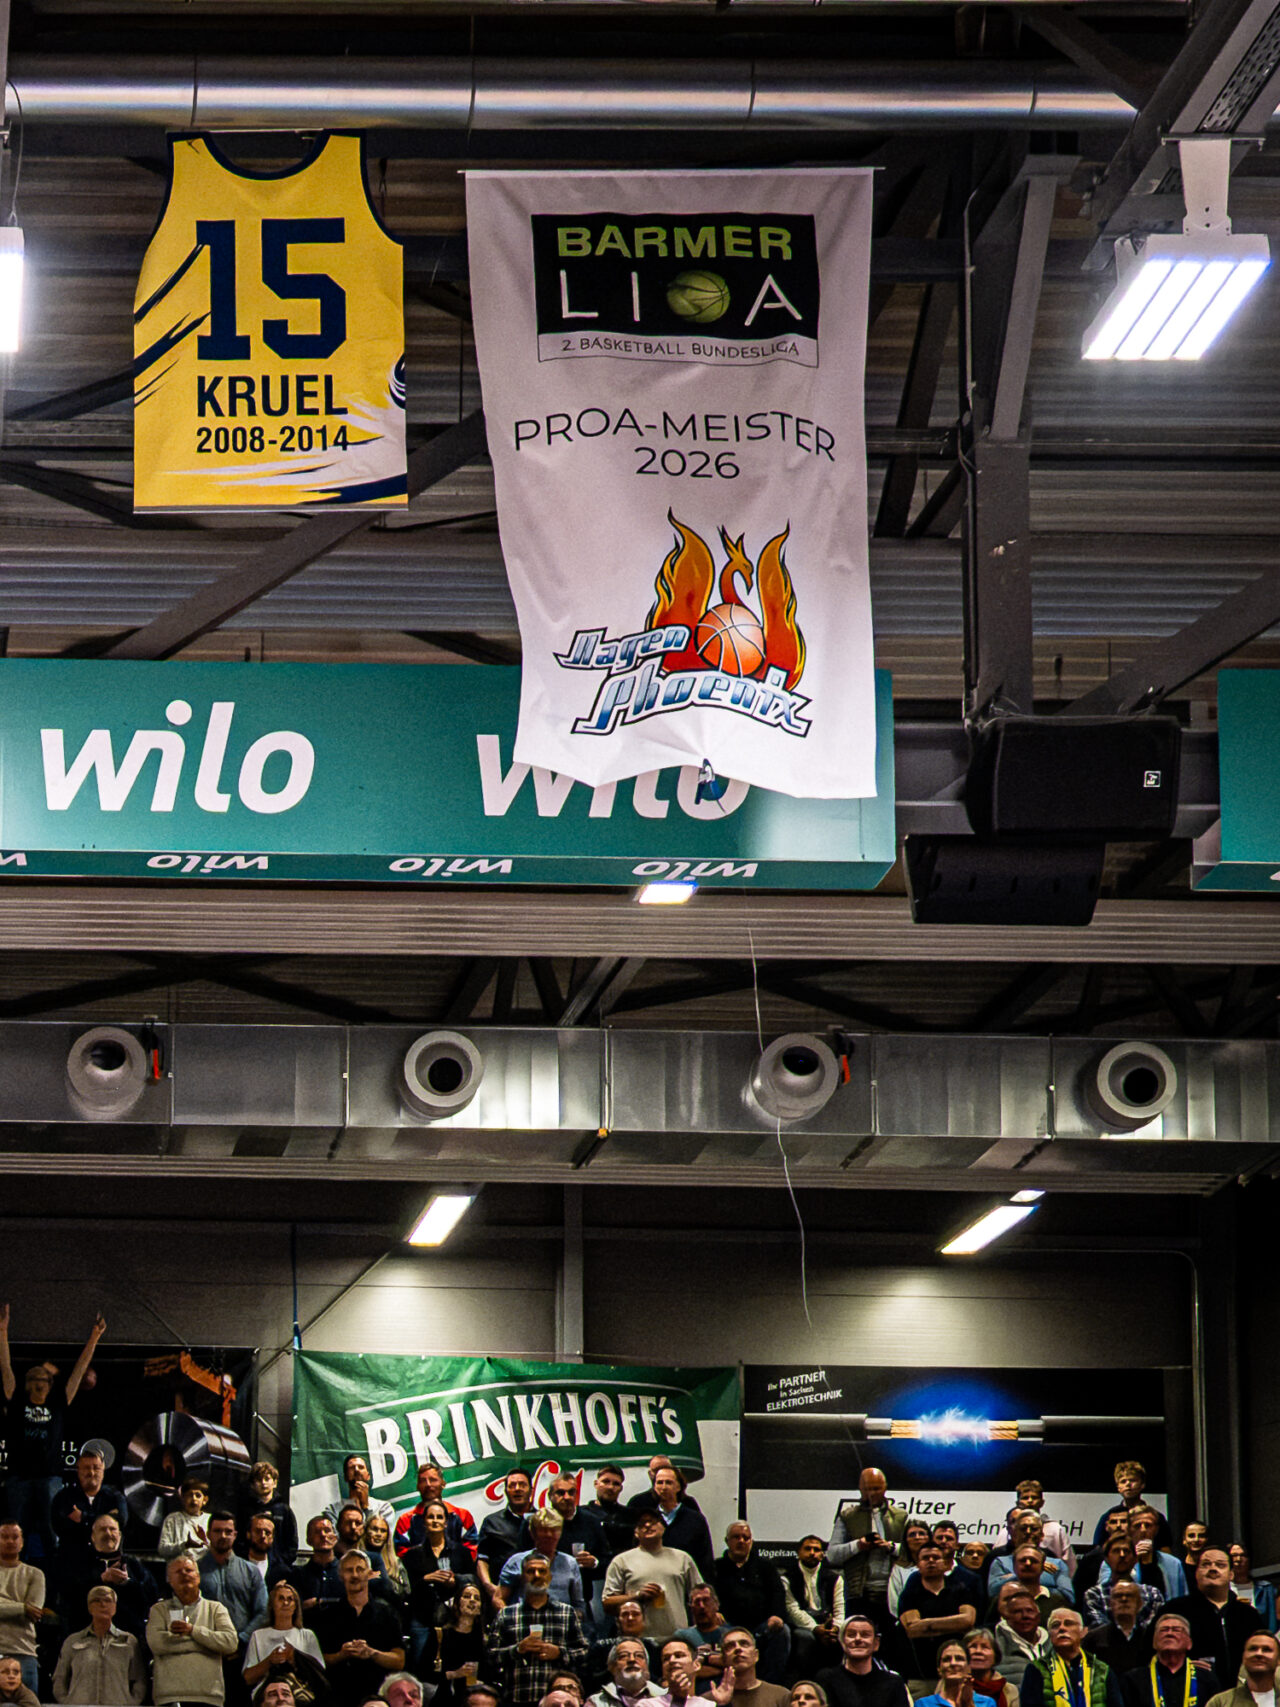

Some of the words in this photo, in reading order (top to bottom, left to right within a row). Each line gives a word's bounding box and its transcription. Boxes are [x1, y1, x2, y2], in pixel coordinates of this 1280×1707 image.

[557, 225, 792, 260] BARMER
[196, 217, 346, 360] 15
[580, 337, 685, 356] BASKETBALL
[692, 340, 800, 358] BUNDESLIGA
[197, 374, 348, 417] KRUEL
[196, 424, 350, 453] 2008-2014
[514, 407, 836, 462] PROA-MEISTER
[634, 446, 740, 479] 2026
[557, 626, 690, 674] Hagen
[575, 659, 807, 735] Phoenix
[40, 699, 315, 814] wilo
[146, 854, 269, 873] wilo
[389, 857, 513, 877] wilo
[780, 1370, 826, 1389] PARTNER
[766, 1389, 843, 1413] ELEKTROTECHNIK
